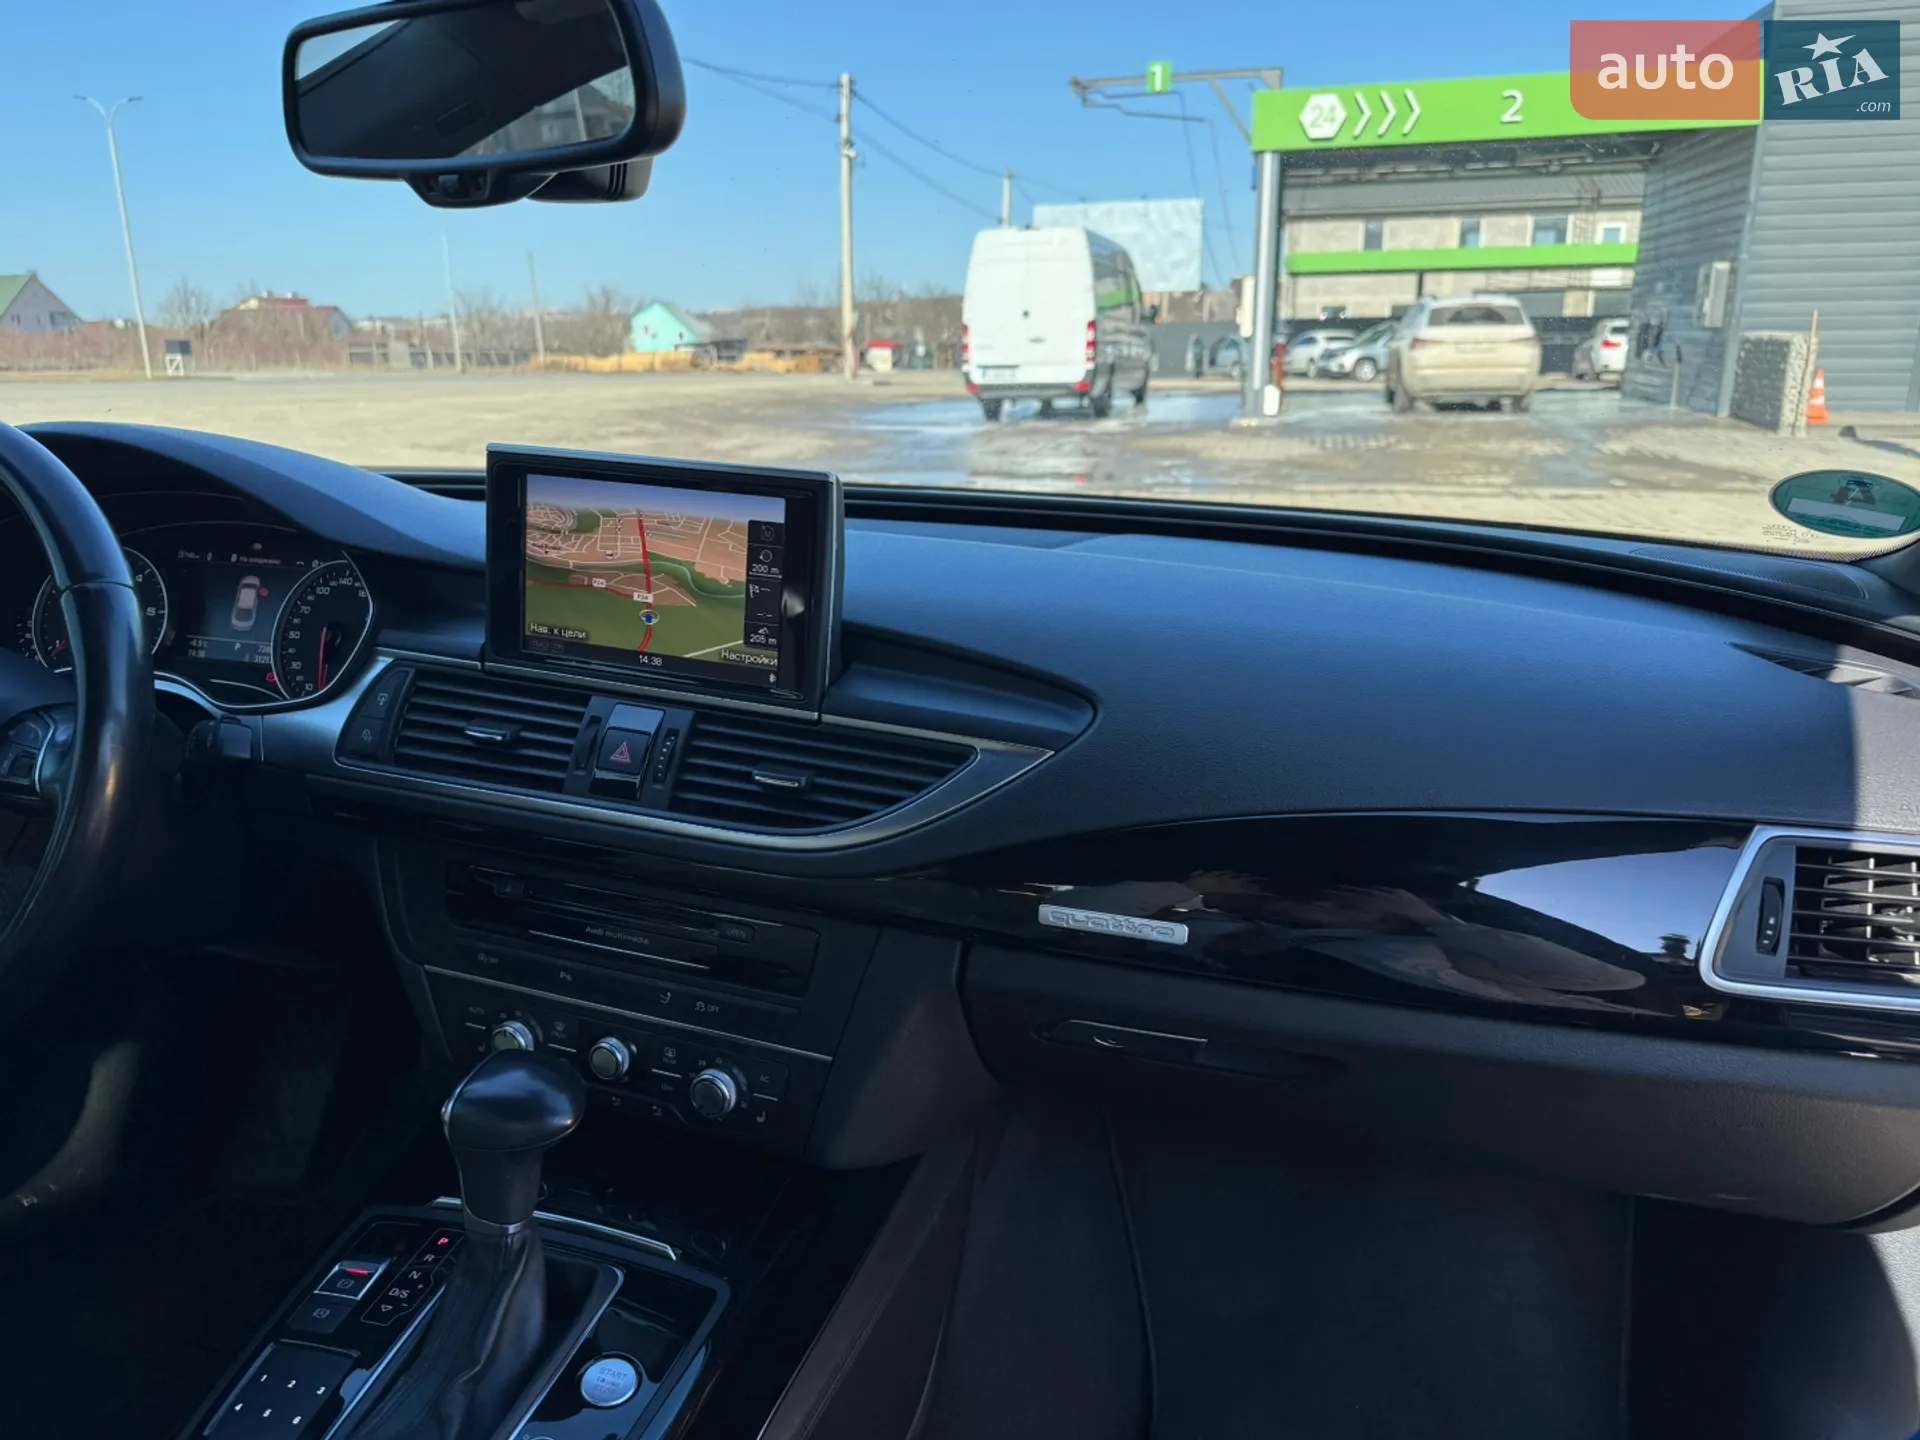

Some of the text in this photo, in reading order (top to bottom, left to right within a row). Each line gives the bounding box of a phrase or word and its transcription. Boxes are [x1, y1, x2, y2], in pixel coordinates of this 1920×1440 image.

[1151, 64, 1163, 91] 1
[1500, 88, 1524, 123] 2
[1309, 105, 1337, 129] 24
[752, 563, 769, 574] 200
[338, 577, 353, 586] 140
[316, 586, 331, 595] 100
[299, 605, 311, 615] 70
[288, 630, 300, 639] 50
[530, 623, 551, 635] Нав.
[561, 629, 587, 640] цели
[749, 633, 766, 644] 205
[638, 654, 663, 667] 14:38
[721, 649, 778, 668] Настройки
[291, 661, 302, 670] 30
[304, 682, 313, 691] 10
[1049, 910, 1175, 939] quattro
[437, 1237, 449, 1246] P
[423, 1253, 435, 1262] R
[409, 1270, 421, 1280] N
[388, 1287, 410, 1299] D/S
[599, 1367, 629, 1380] START
[261, 1374, 326, 1395] 1 2 3
[234, 1402, 302, 1425] 4 5 6
